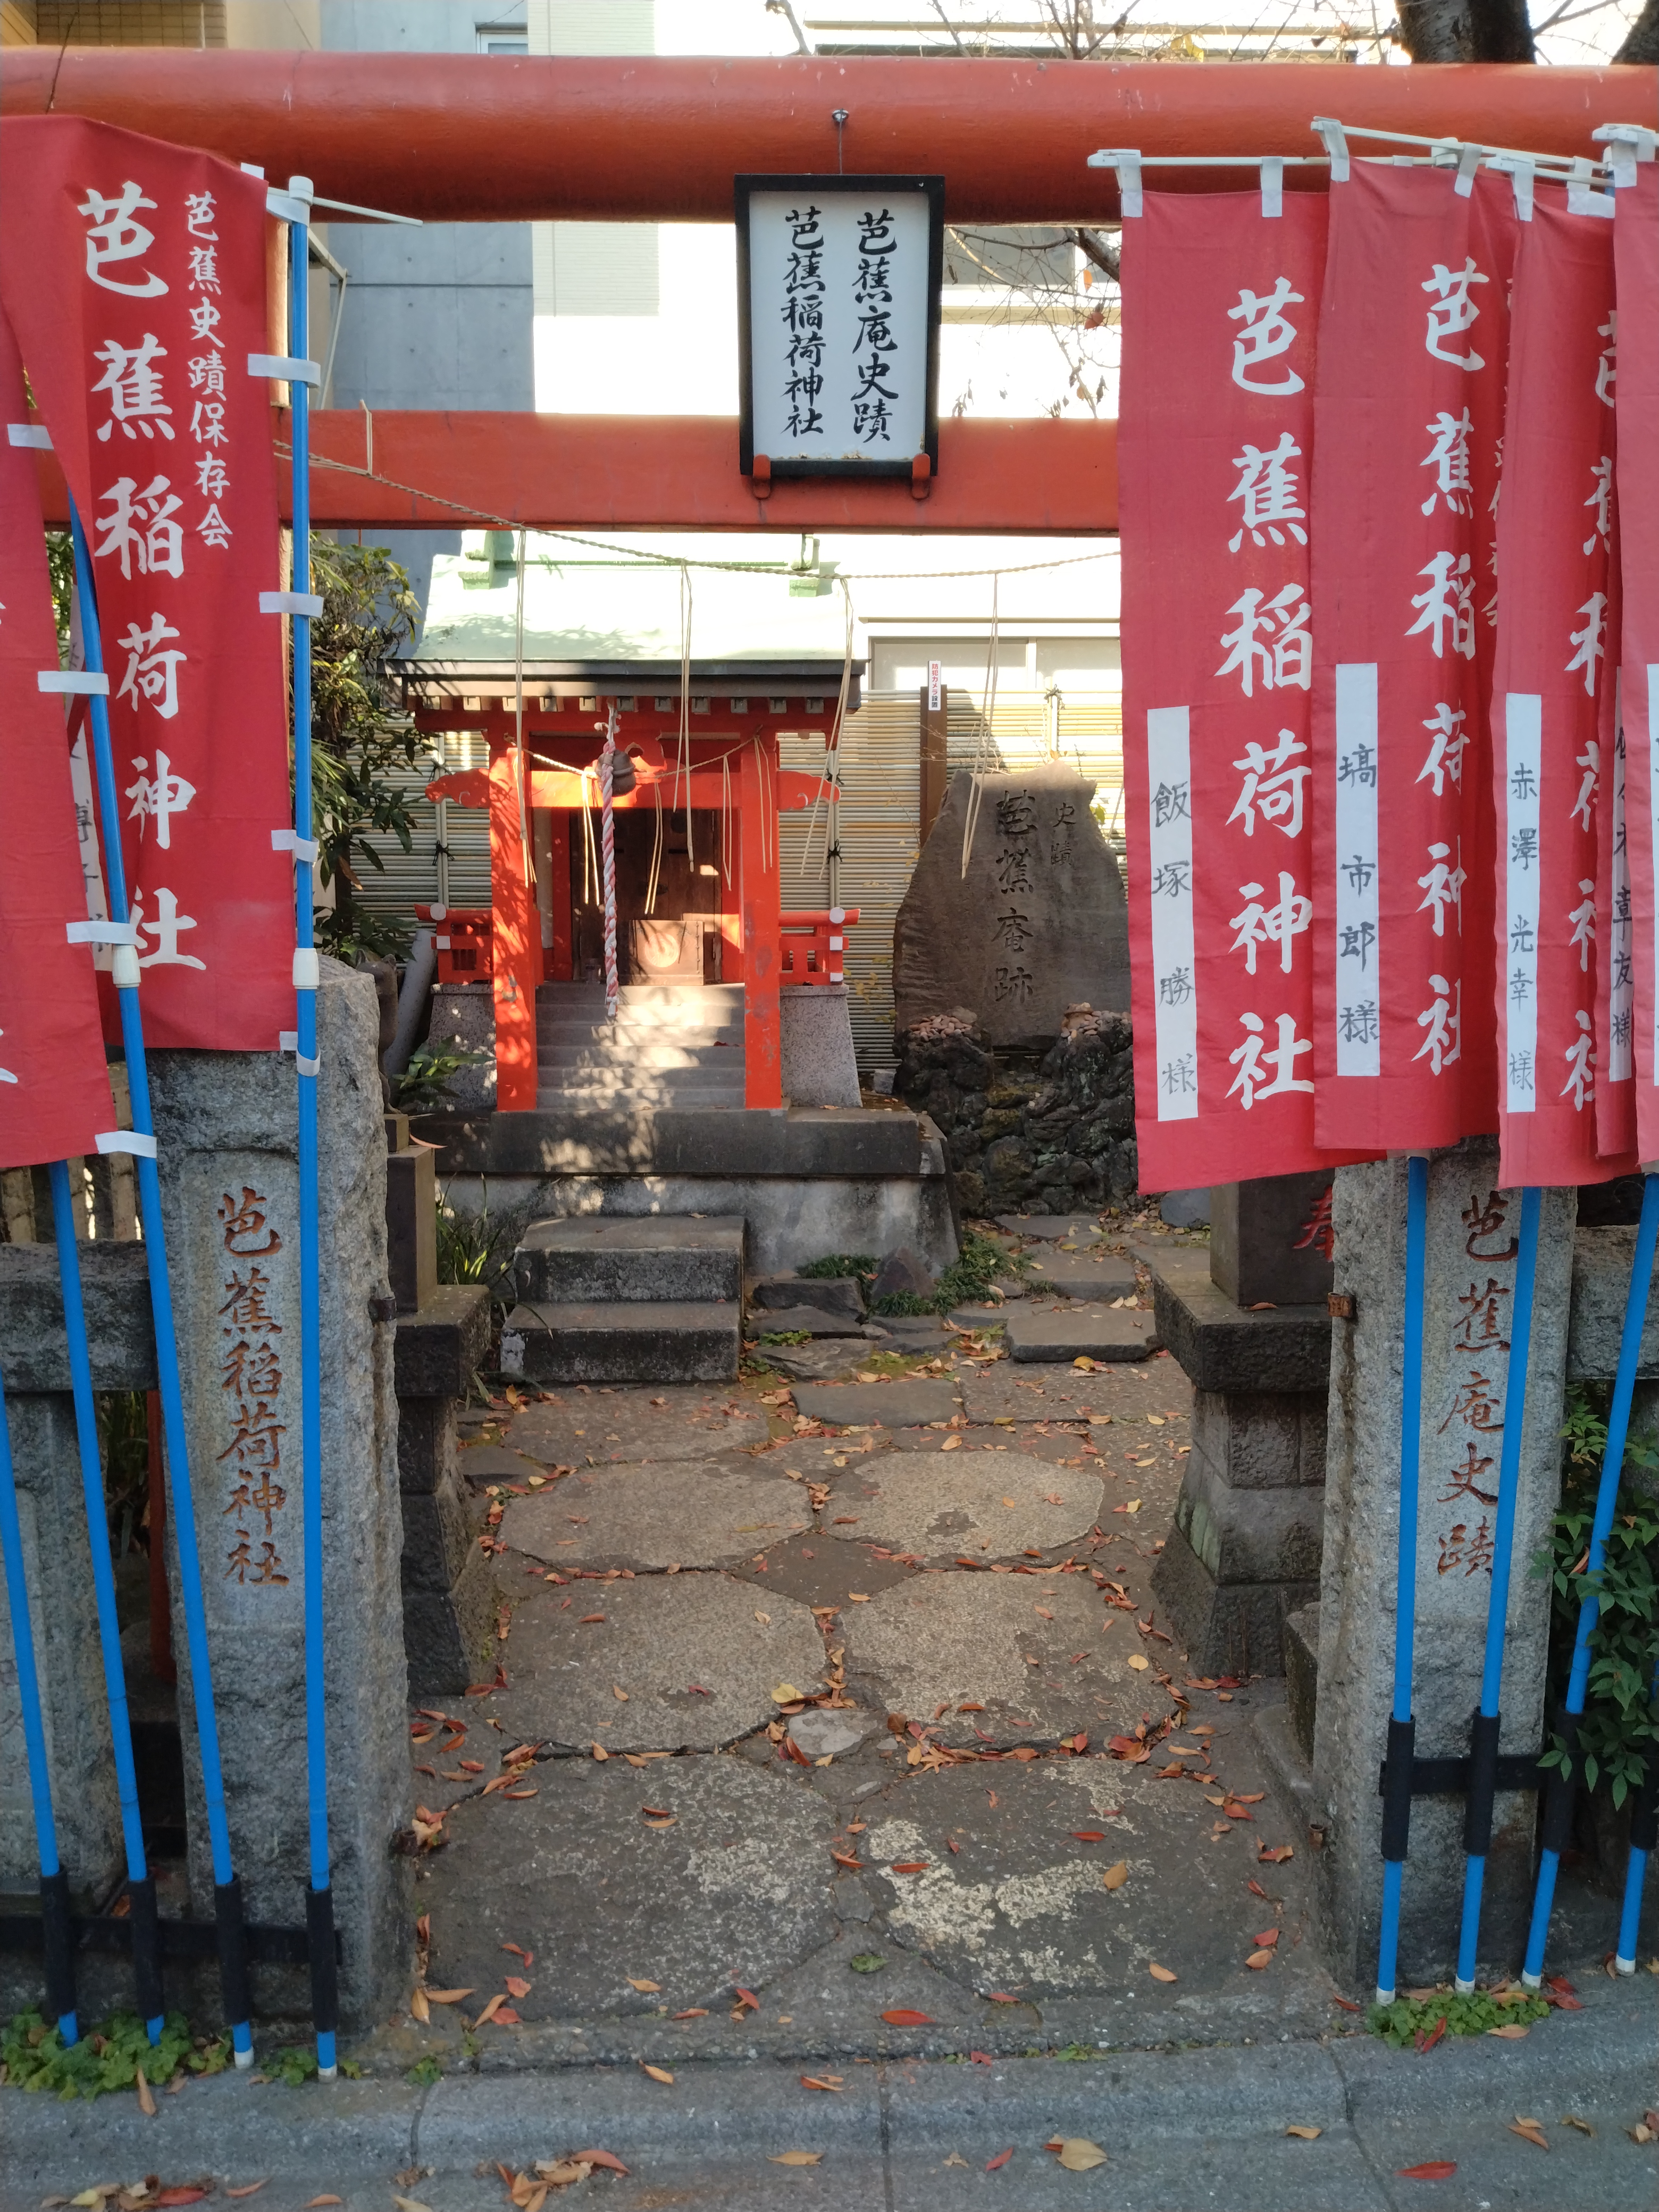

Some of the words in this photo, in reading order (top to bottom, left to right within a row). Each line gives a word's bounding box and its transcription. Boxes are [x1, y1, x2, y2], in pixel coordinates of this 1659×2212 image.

[185, 191, 232, 549] 芭蕉史蹟保存会
[781, 206, 826, 438] 芭蕉稲荷神社
[851, 209, 899, 443] 芭蕉庵史蹟
[78, 180, 206, 971] 芭蕉稲荷神社
[1214, 276, 1314, 1110] 芭蕉稲荷神社
[216, 1186, 289, 1586] 芭蕉稲荷神社
